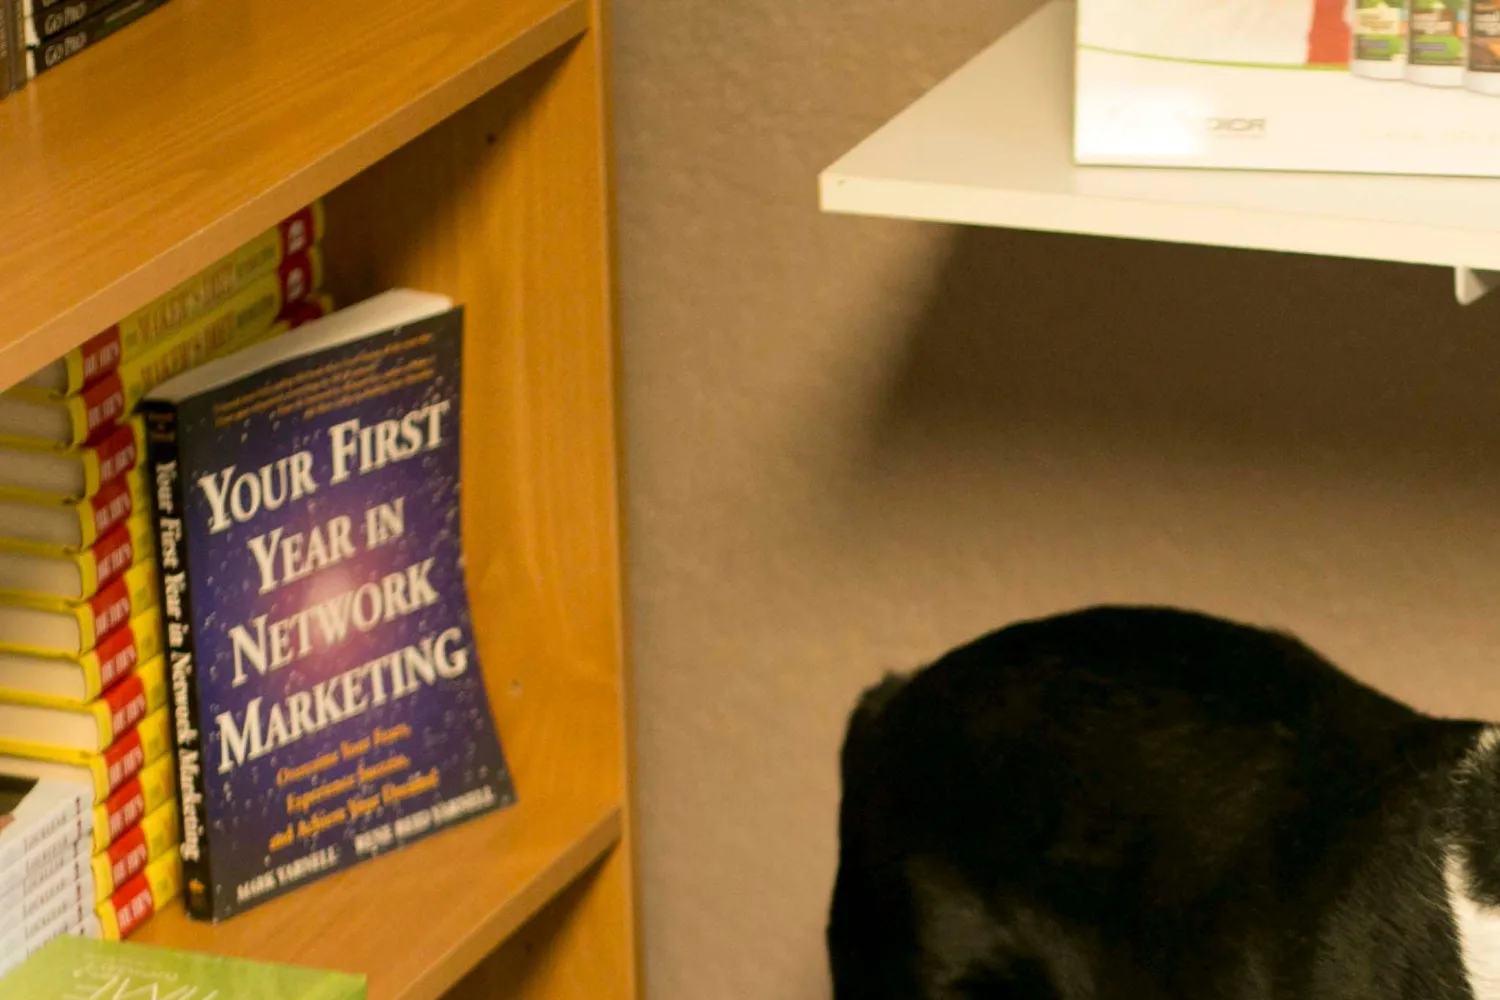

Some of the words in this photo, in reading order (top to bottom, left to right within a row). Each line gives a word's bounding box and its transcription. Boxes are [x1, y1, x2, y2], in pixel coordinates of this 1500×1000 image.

[198, 450, 318, 535] YOUR
[328, 400, 450, 486] FIRST
[247, 516, 356, 595] YEAR
[365, 497, 405, 549] IN
[228, 557, 440, 688] NETWORK
[215, 627, 469, 776] MARKETING
[178, 749, 203, 862] Marketing
